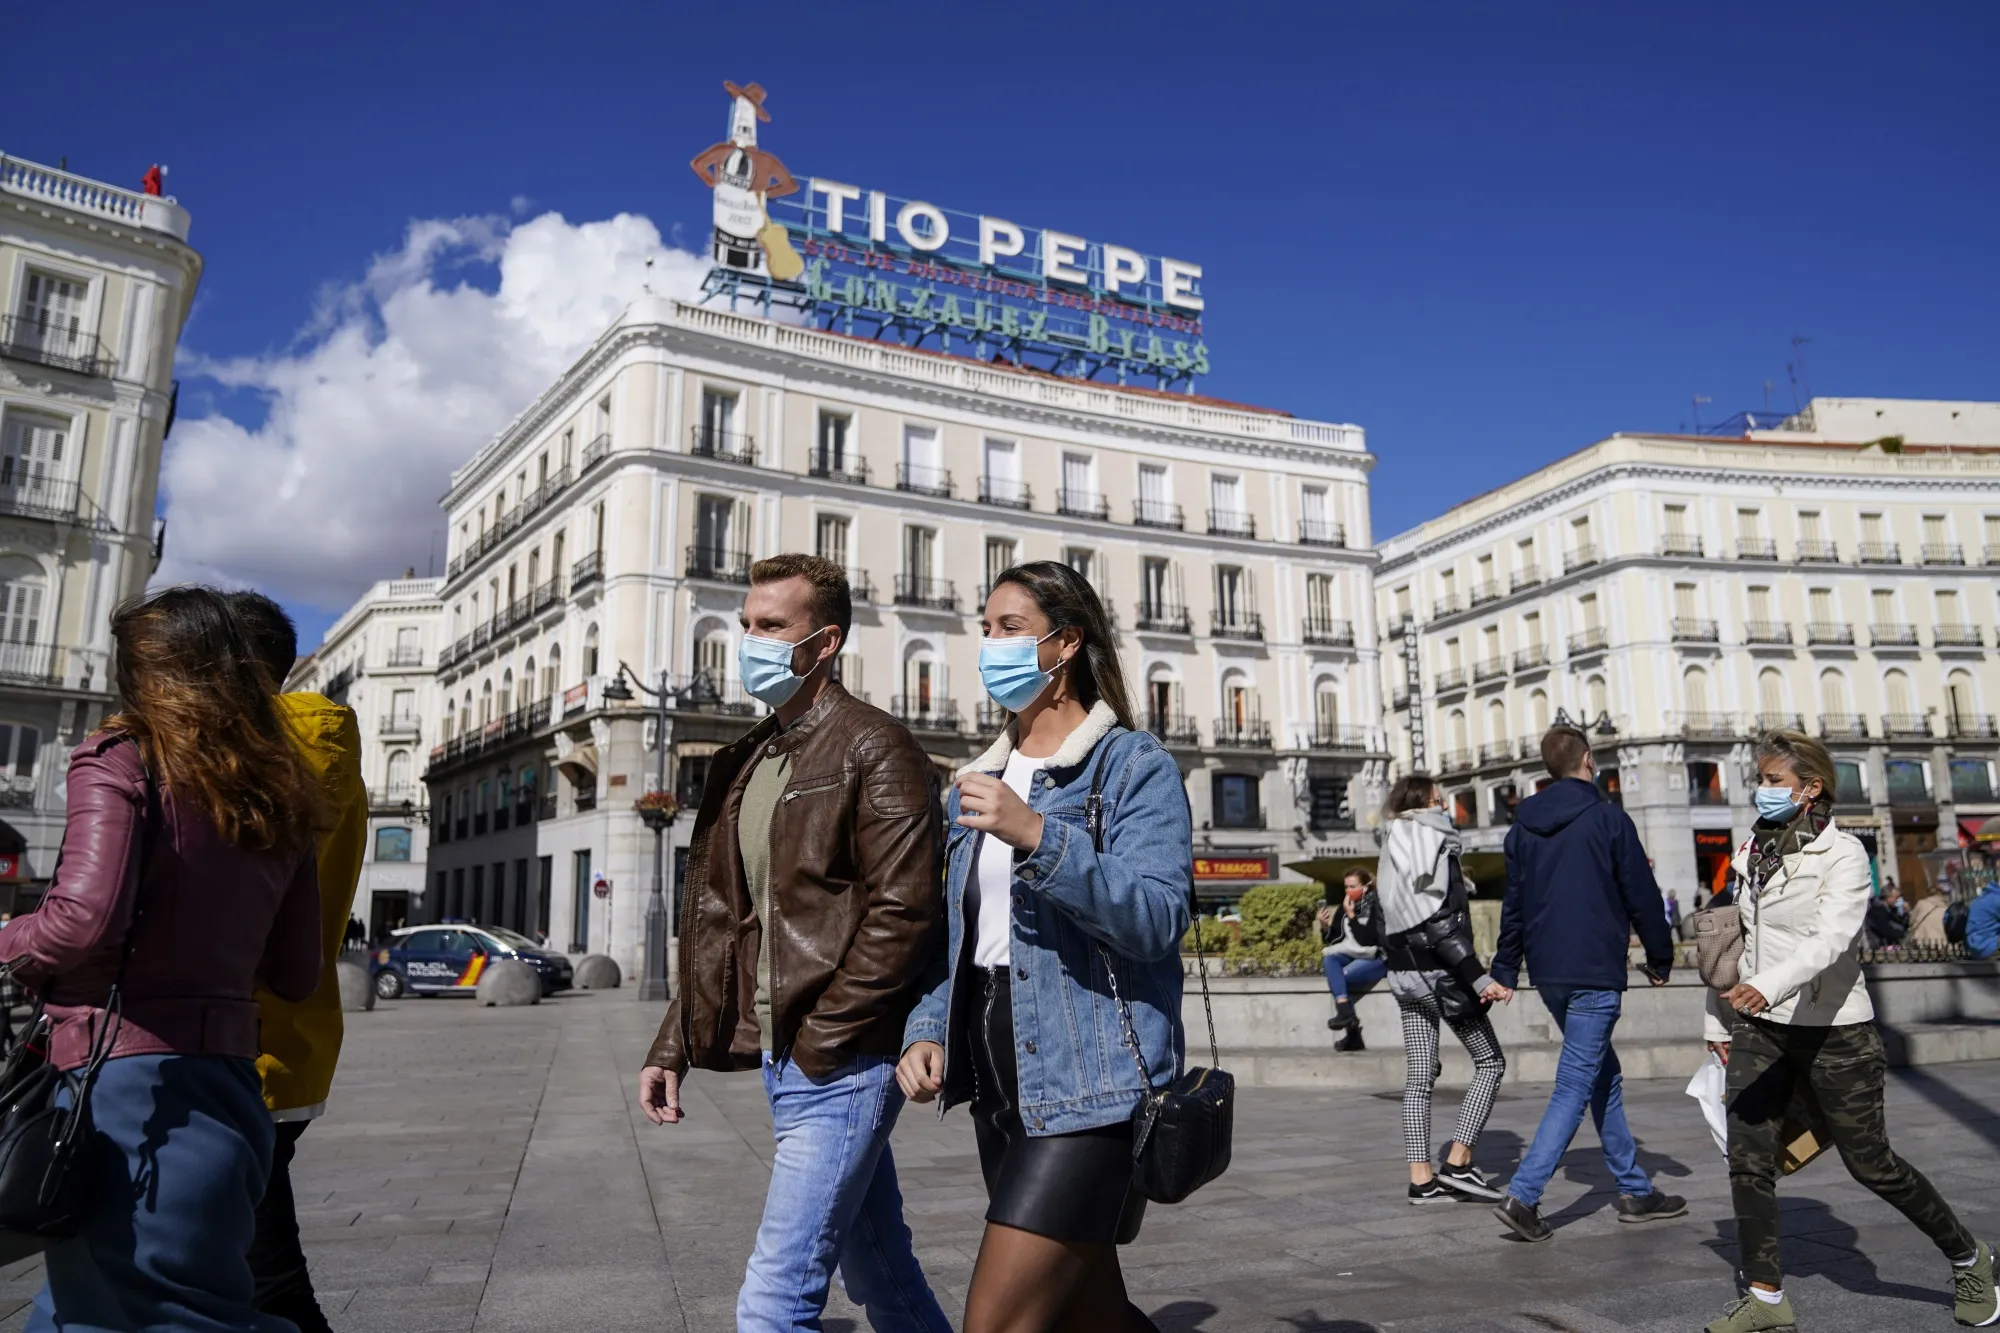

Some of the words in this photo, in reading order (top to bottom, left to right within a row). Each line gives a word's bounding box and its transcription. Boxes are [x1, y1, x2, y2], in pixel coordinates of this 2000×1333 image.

[803, 239, 856, 263] SOL
[864, 250, 895, 271] DE
[810, 177, 949, 251] TIO
[979, 215, 1204, 311] PEPE
[810, 258, 1048, 341] GONZALEZ
[1088, 313, 1210, 375] BYASS
[1404, 621, 1419, 685] HOTEL
[1410, 693, 1425, 770] EUROPA
[1696, 833, 1728, 846] Orange
[1213, 863, 1262, 874] TABACOS
[407, 961, 447, 969] POLICIA
[407, 968, 460, 977] NACIONAL
